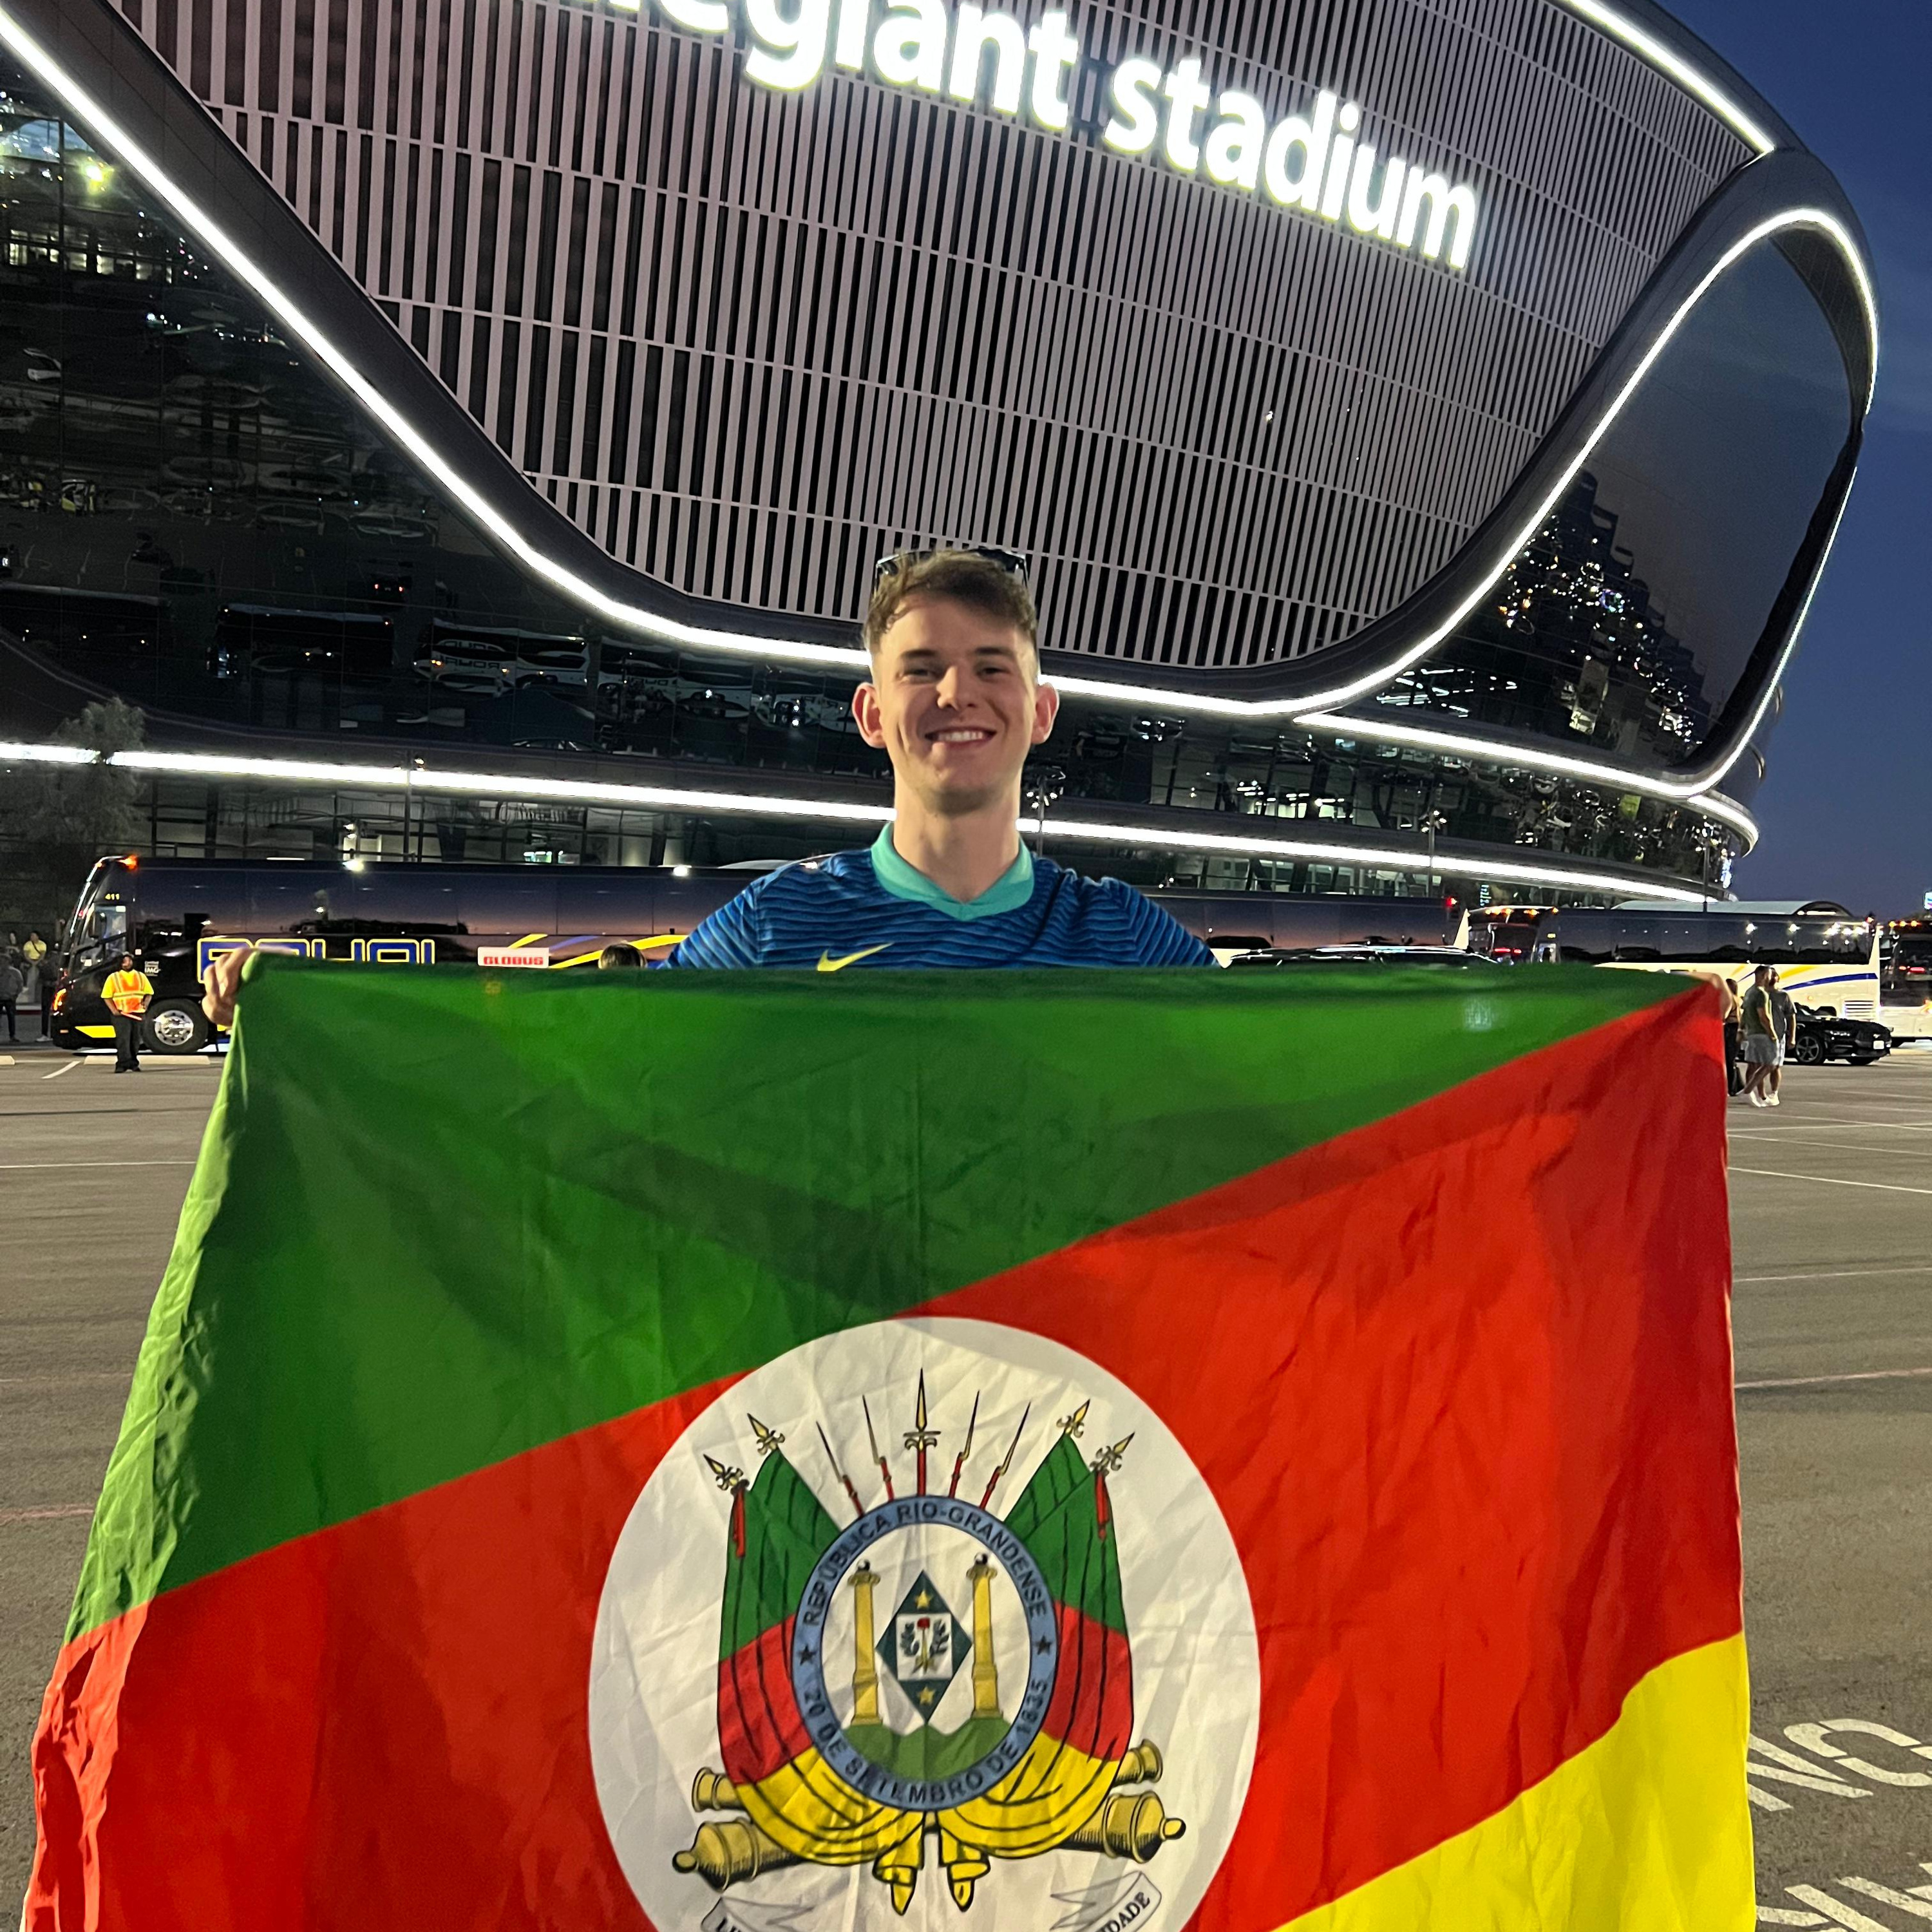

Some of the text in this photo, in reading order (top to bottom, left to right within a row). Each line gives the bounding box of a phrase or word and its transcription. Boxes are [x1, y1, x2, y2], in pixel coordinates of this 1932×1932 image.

[1103, 54, 1479, 270] stadium
[483, 956, 544, 965] GLOBUS
[896, 1502, 1047, 1618] RIO-GRANDENSE
[804, 1689, 826, 1718] 20
[817, 1722, 849, 1759] DE
[985, 1739, 1020, 1774] DE
[1015, 1678, 1048, 1735] 1835
[1095, 1891, 1150, 1932] DADE
